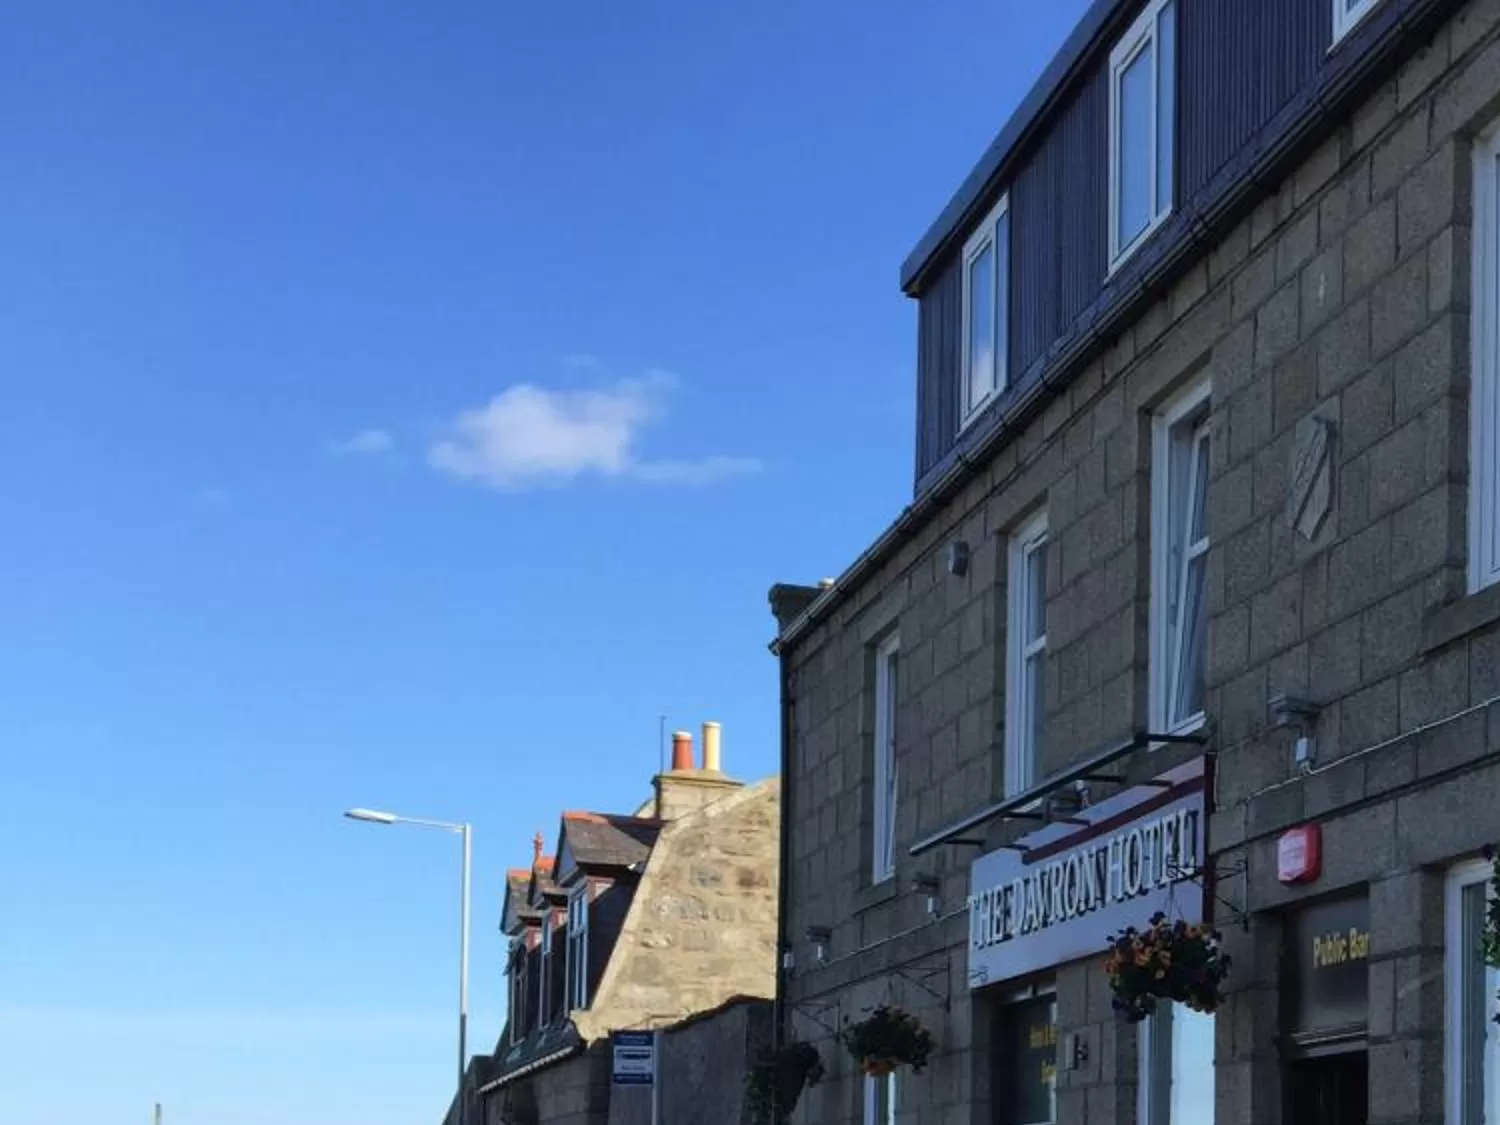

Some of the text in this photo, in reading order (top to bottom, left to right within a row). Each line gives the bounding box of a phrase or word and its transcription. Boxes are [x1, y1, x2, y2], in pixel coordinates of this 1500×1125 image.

[968, 883, 1006, 949] THE
[1104, 807, 1197, 905] HOTEL
[1349, 927, 1369, 960] Bar
